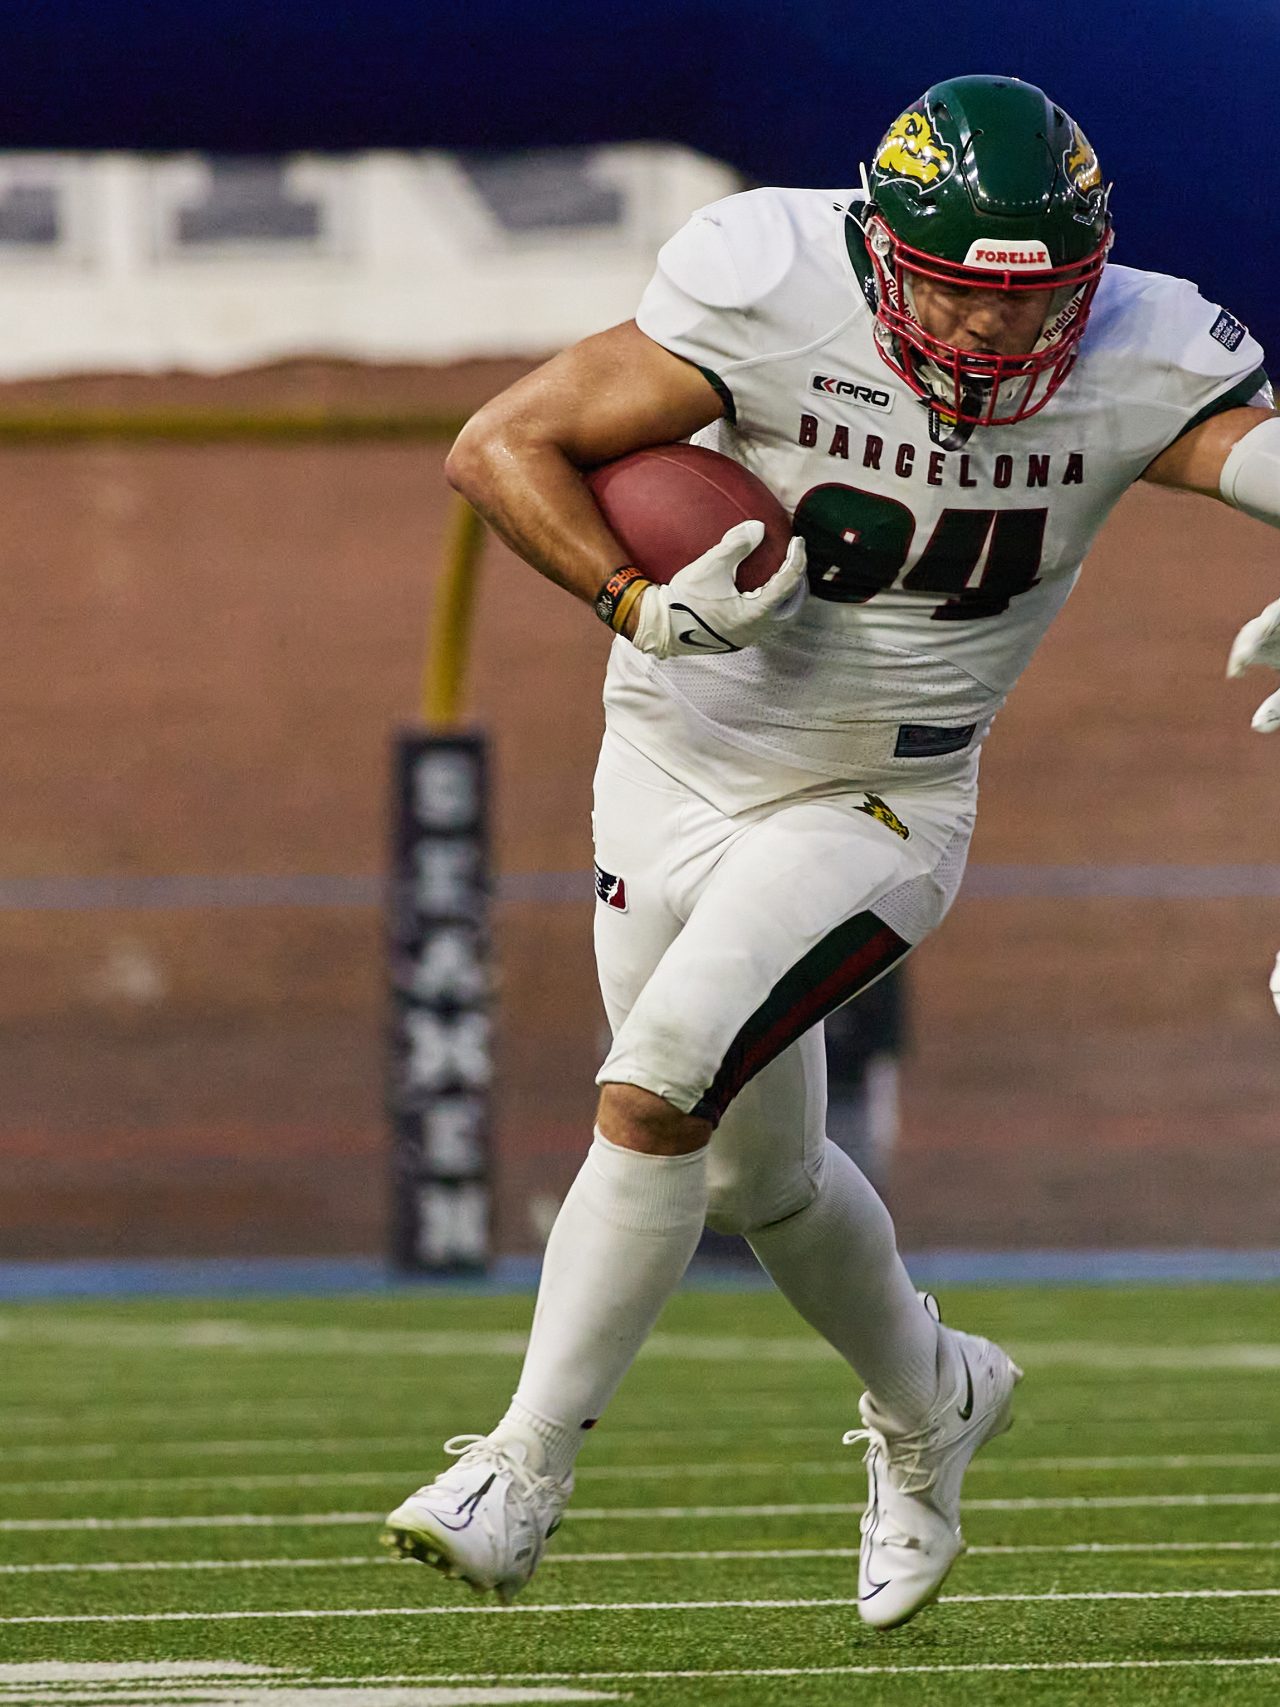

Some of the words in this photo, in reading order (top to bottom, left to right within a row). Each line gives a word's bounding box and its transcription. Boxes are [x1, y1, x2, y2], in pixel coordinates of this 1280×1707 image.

[975, 249, 1047, 264] FORELLE
[1042, 296, 1083, 343] Riddell
[798, 413, 1084, 489] BARCELONA
[793, 482, 1048, 621] 84
